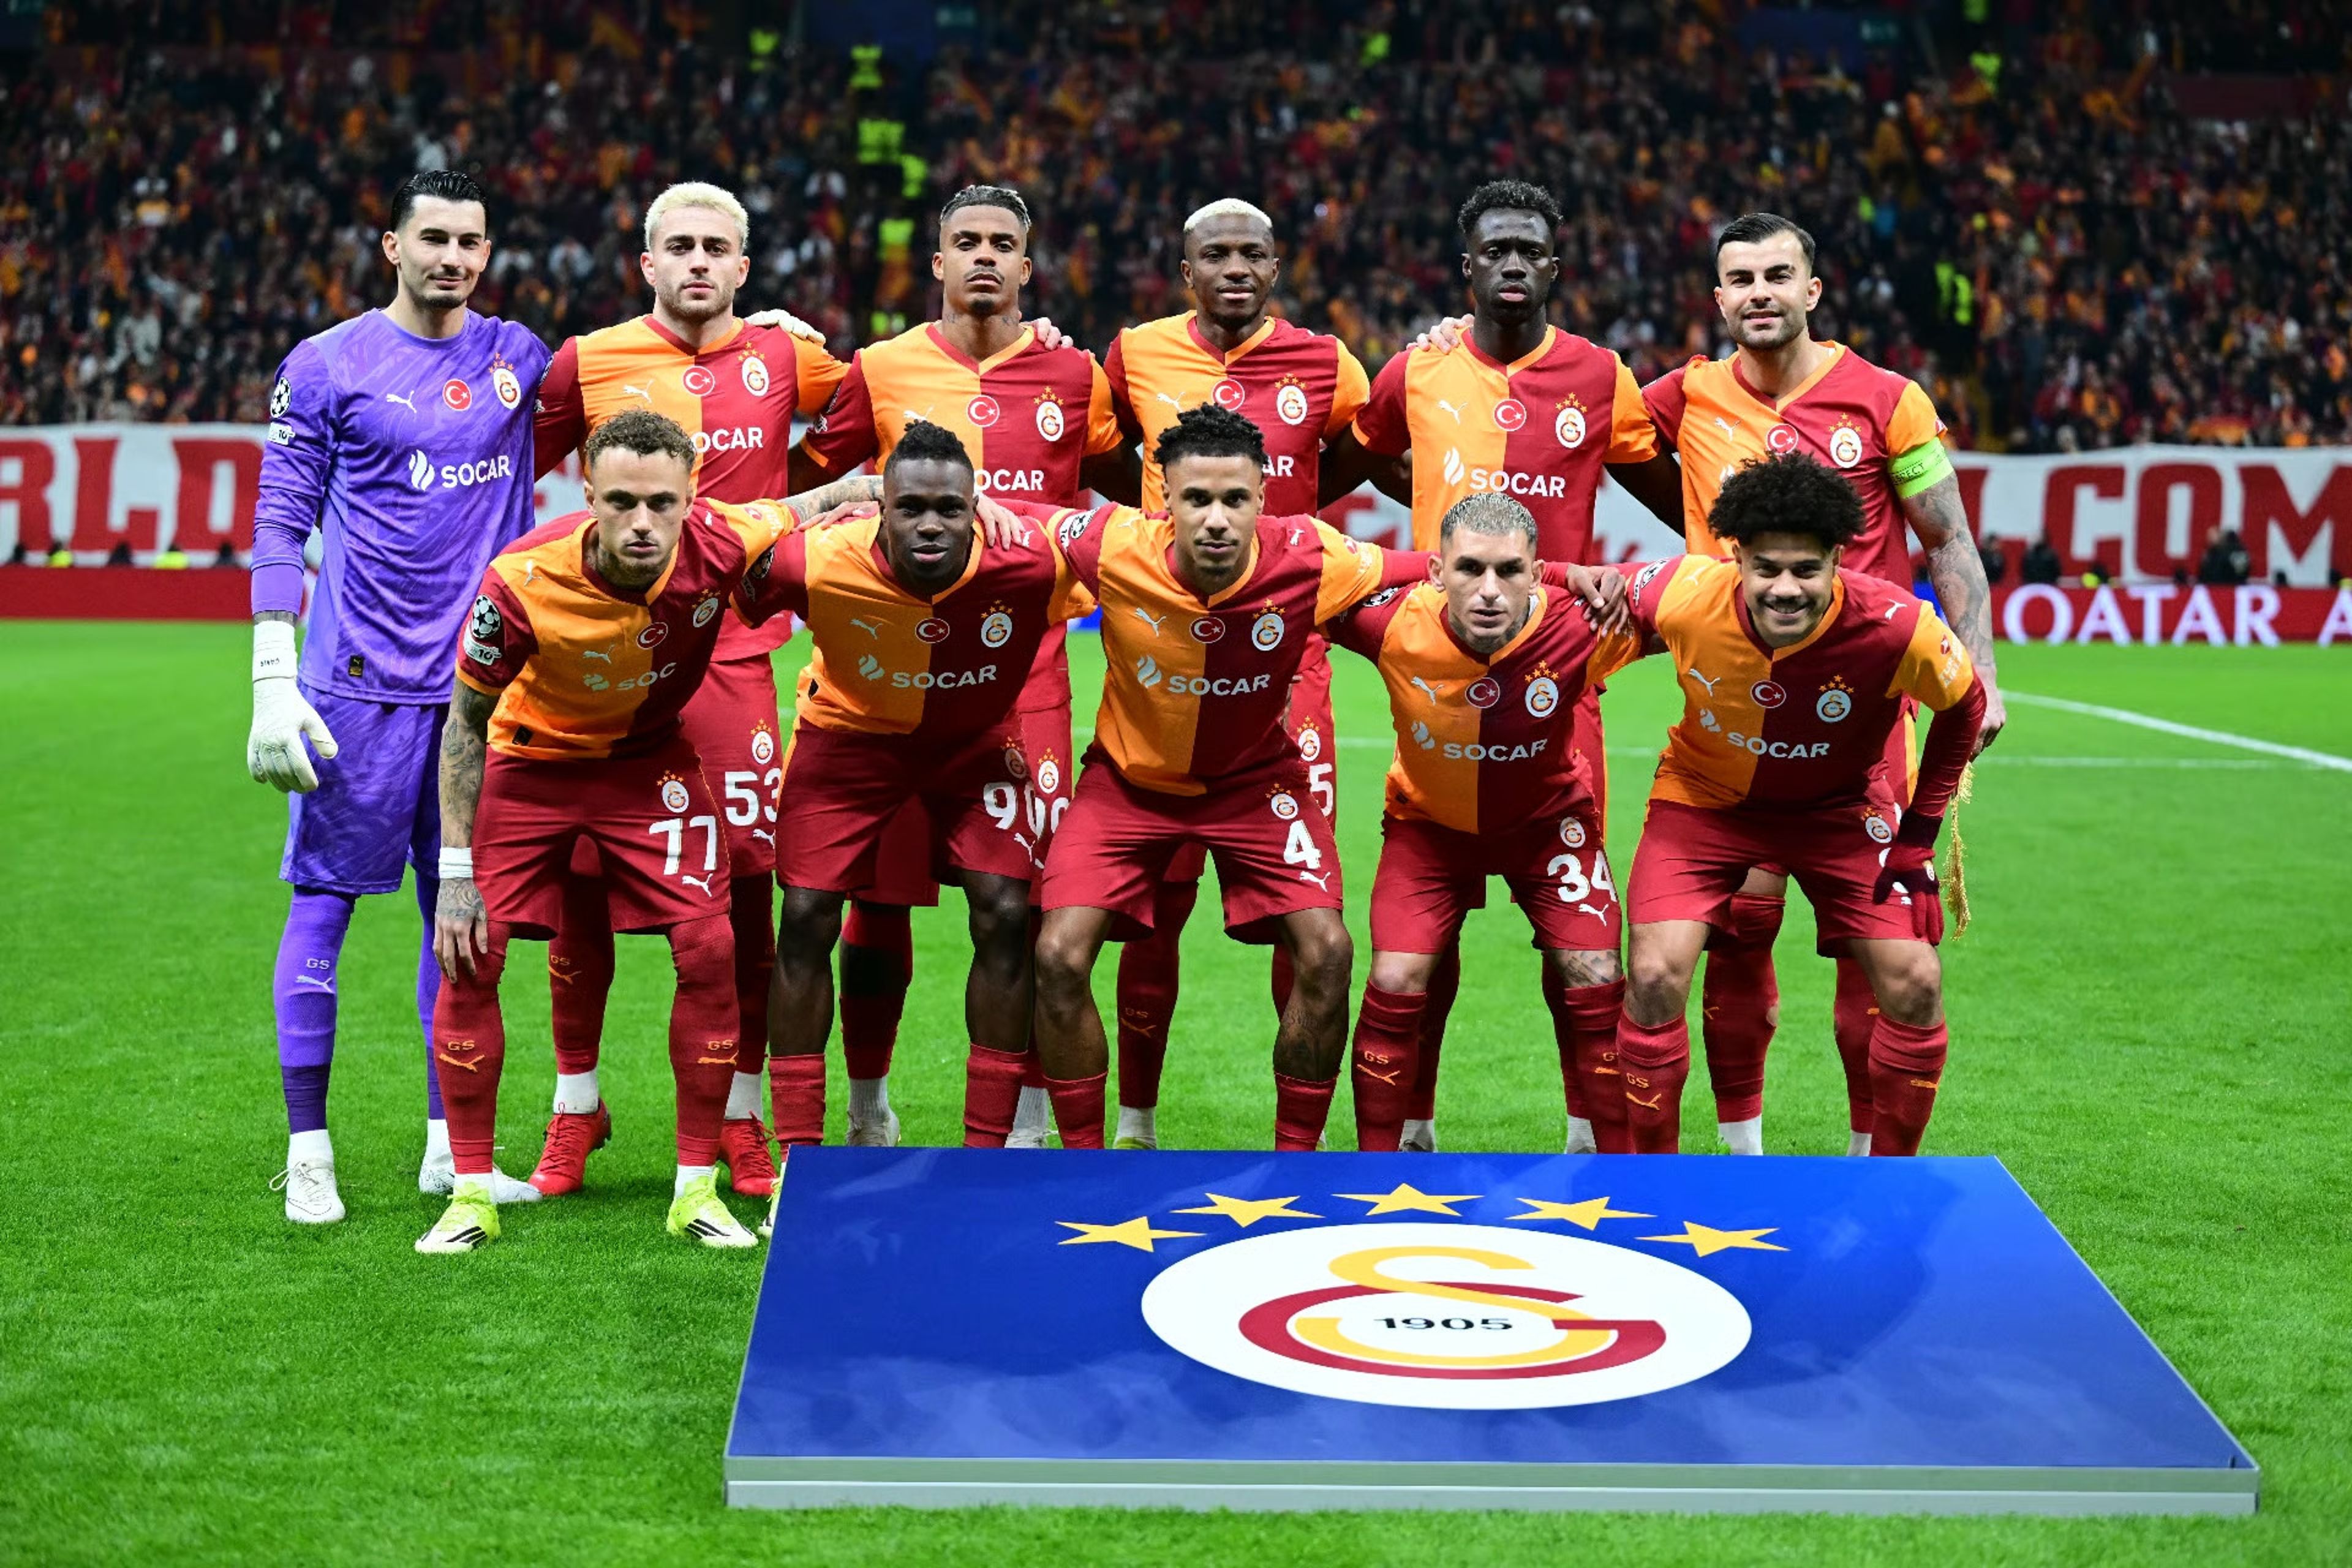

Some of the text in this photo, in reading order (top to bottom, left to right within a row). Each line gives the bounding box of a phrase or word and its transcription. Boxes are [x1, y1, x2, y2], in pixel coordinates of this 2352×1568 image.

[691, 427, 763, 454] OCAR
[441, 455, 511, 488] SOCAR
[974, 469, 1044, 491] OCAR
[1469, 468, 1566, 498] SOCAR
[2003, 583, 2282, 647] QATAR
[616, 662, 676, 690] SOC
[891, 665, 997, 688] SOCAR
[1167, 674, 1270, 696] SOCAR
[1443, 738, 1548, 761] SOCAR
[1727, 731, 1830, 759] SOCAR
[1308, 763, 1333, 816] 5
[649, 815, 717, 875] 77
[1283, 820, 1322, 869] 4
[1548, 850, 1617, 902] 34
[306, 958, 330, 969] GS
[448, 1040, 475, 1050] GS
[707, 1039, 733, 1050] GS
[1364, 1050, 1389, 1065] GS
[1626, 1072, 1649, 1088] GS
[1374, 1317, 1512, 1331] 1905
